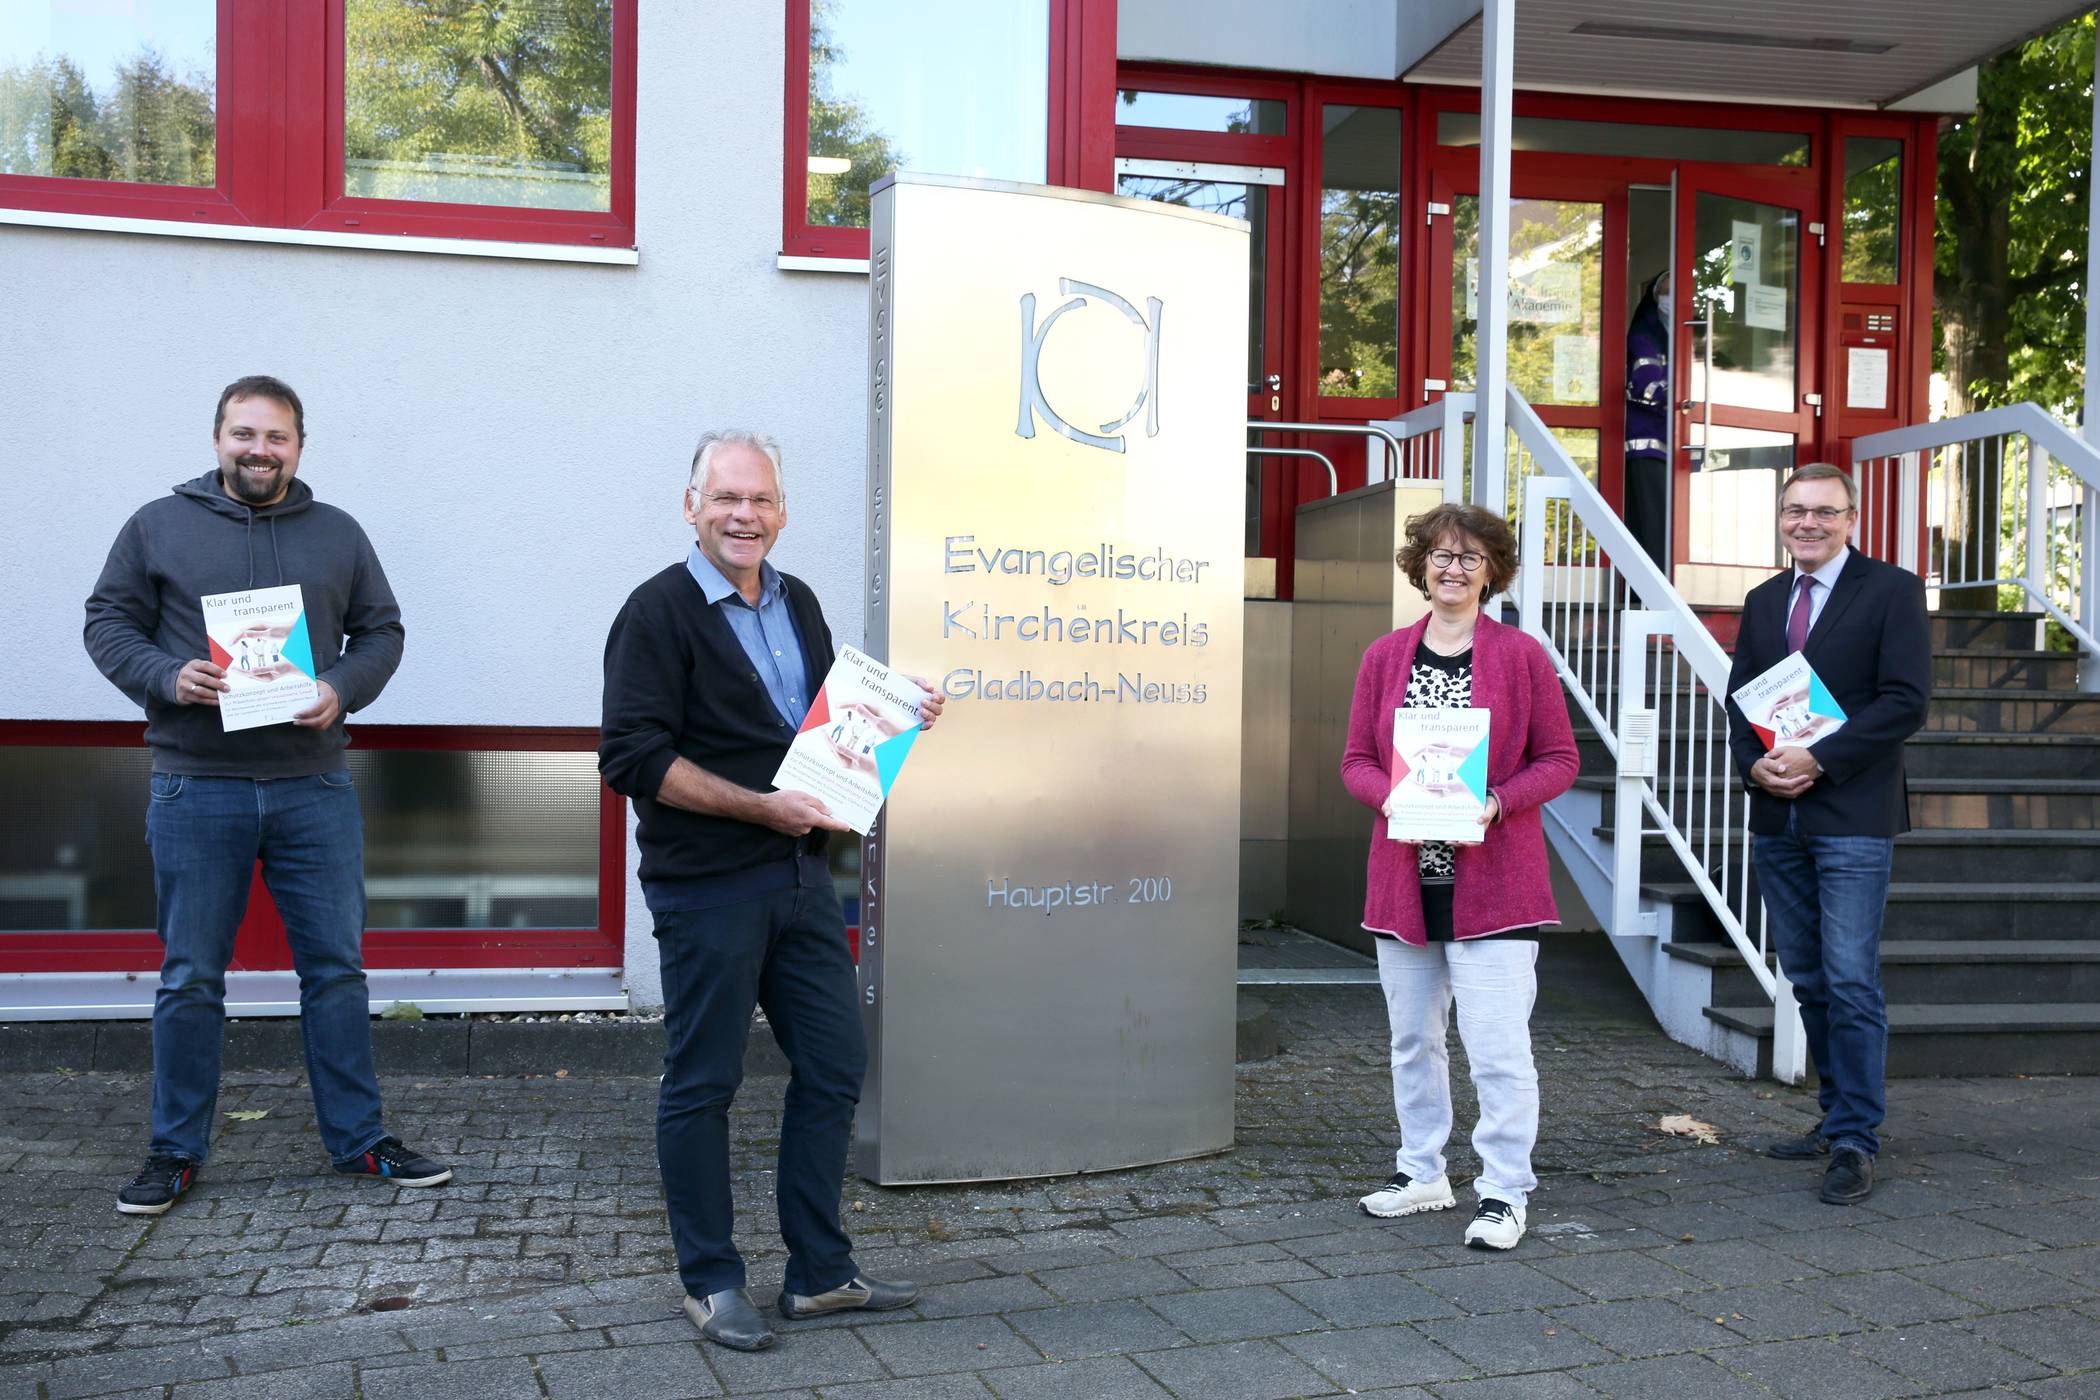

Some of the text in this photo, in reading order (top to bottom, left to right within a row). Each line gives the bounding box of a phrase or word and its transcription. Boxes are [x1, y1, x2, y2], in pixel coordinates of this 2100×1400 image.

[1511, 297, 1573, 313] Akademie
[945, 535, 1209, 585] Evangelischer
[206, 594, 252, 608] Klar und
[233, 601, 295, 618] transparent
[943, 600, 1209, 647] Kirchenkreis
[843, 649, 889, 681] Klar und
[942, 668, 1207, 703] Gladbach-Neuss
[1736, 677, 1768, 701] Klar und
[1757, 667, 1803, 699] transparent
[860, 676, 920, 716] transparent
[1398, 712, 1440, 720] Klar und
[1421, 723, 1479, 733] transparent
[835, 771, 850, 784] und
[1128, 877, 1172, 904] 200
